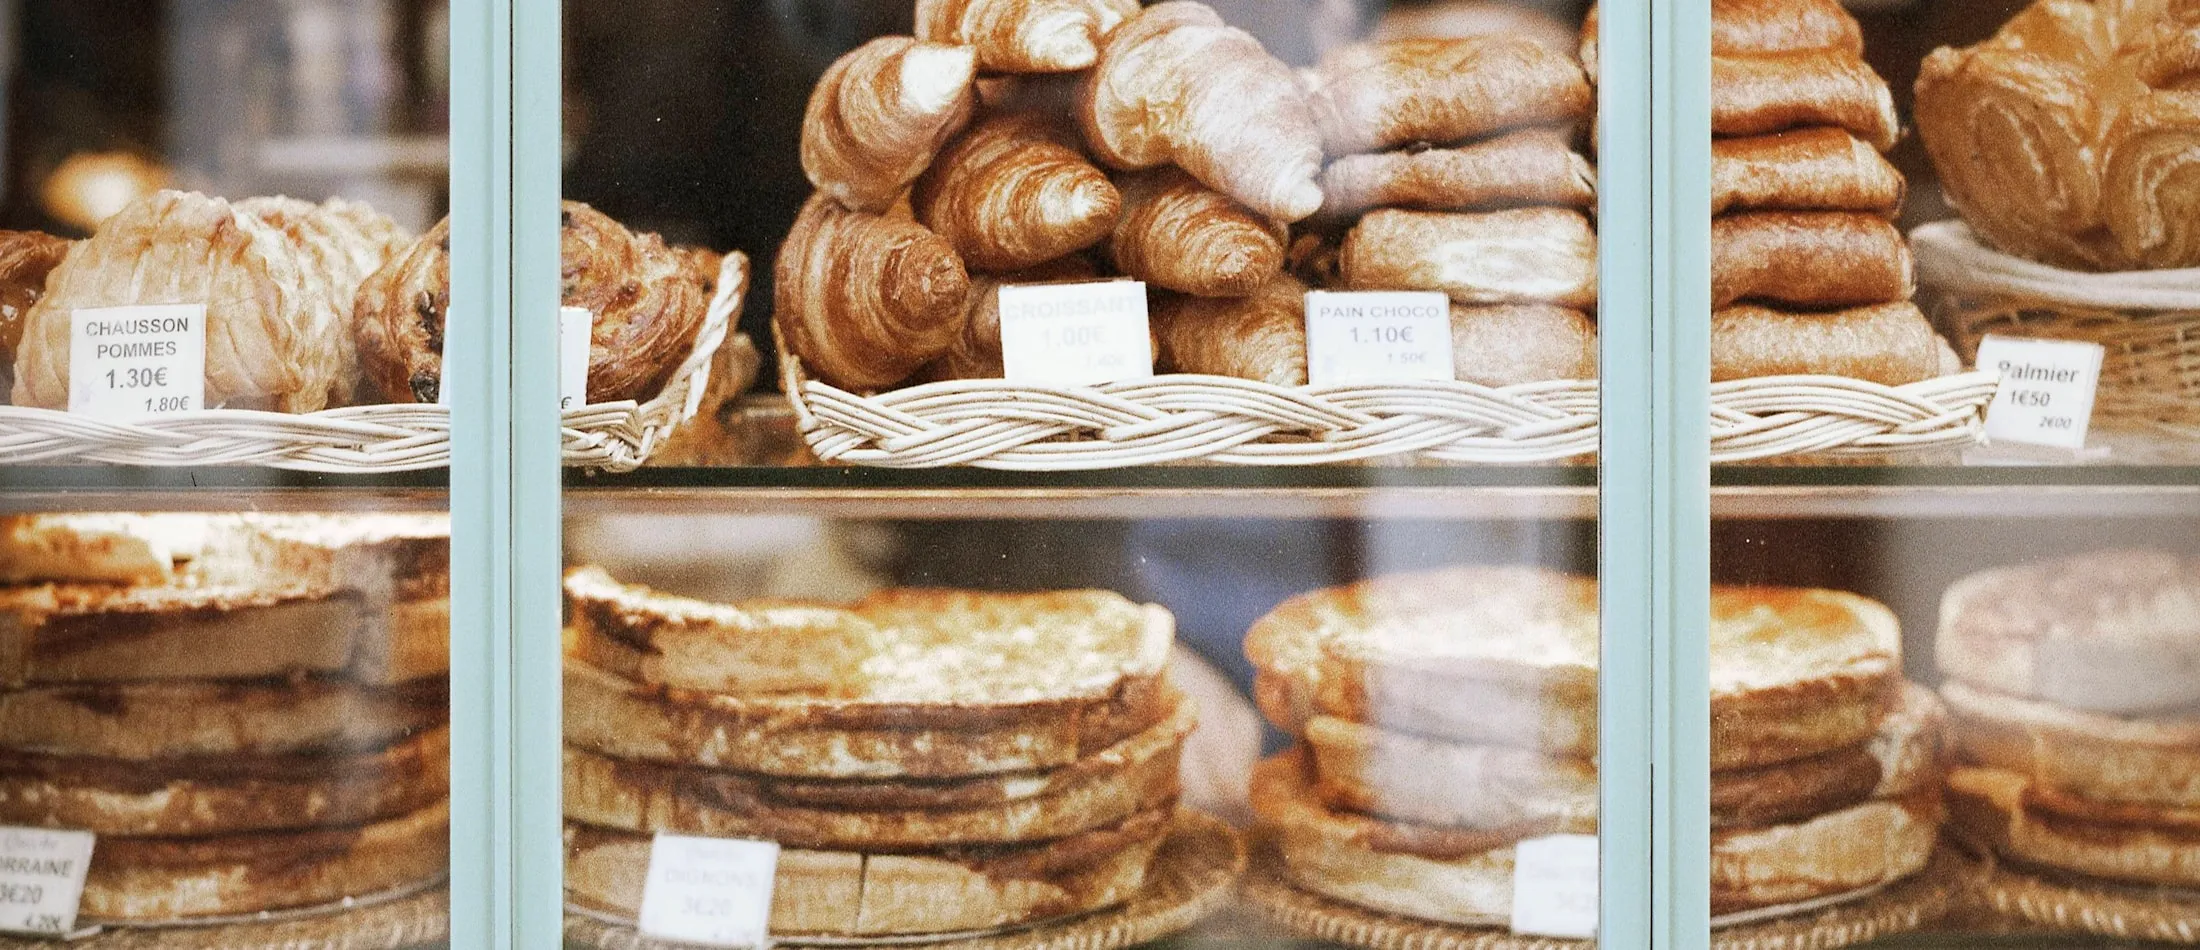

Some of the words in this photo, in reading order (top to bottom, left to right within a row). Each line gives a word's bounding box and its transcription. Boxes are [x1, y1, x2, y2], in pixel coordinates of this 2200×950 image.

[1004, 295, 1139, 321] CROISSANT
[1320, 305, 1363, 318] PAIN
[1370, 305, 1439, 318] CHOCO
[86, 317, 189, 336] CHAUSSON
[1350, 325, 1414, 343] 1.10€
[1041, 325, 1107, 349] 1.00€
[97, 341, 177, 359] POMMES
[1387, 352, 1428, 365] 150€
[106, 367, 168, 389] 1.30€
[1998, 360, 2079, 383] Palmier
[145, 396, 190, 412] 1.80€
[2010, 390, 2051, 407] 1€50
[0, 856, 73, 878] RRAINE
